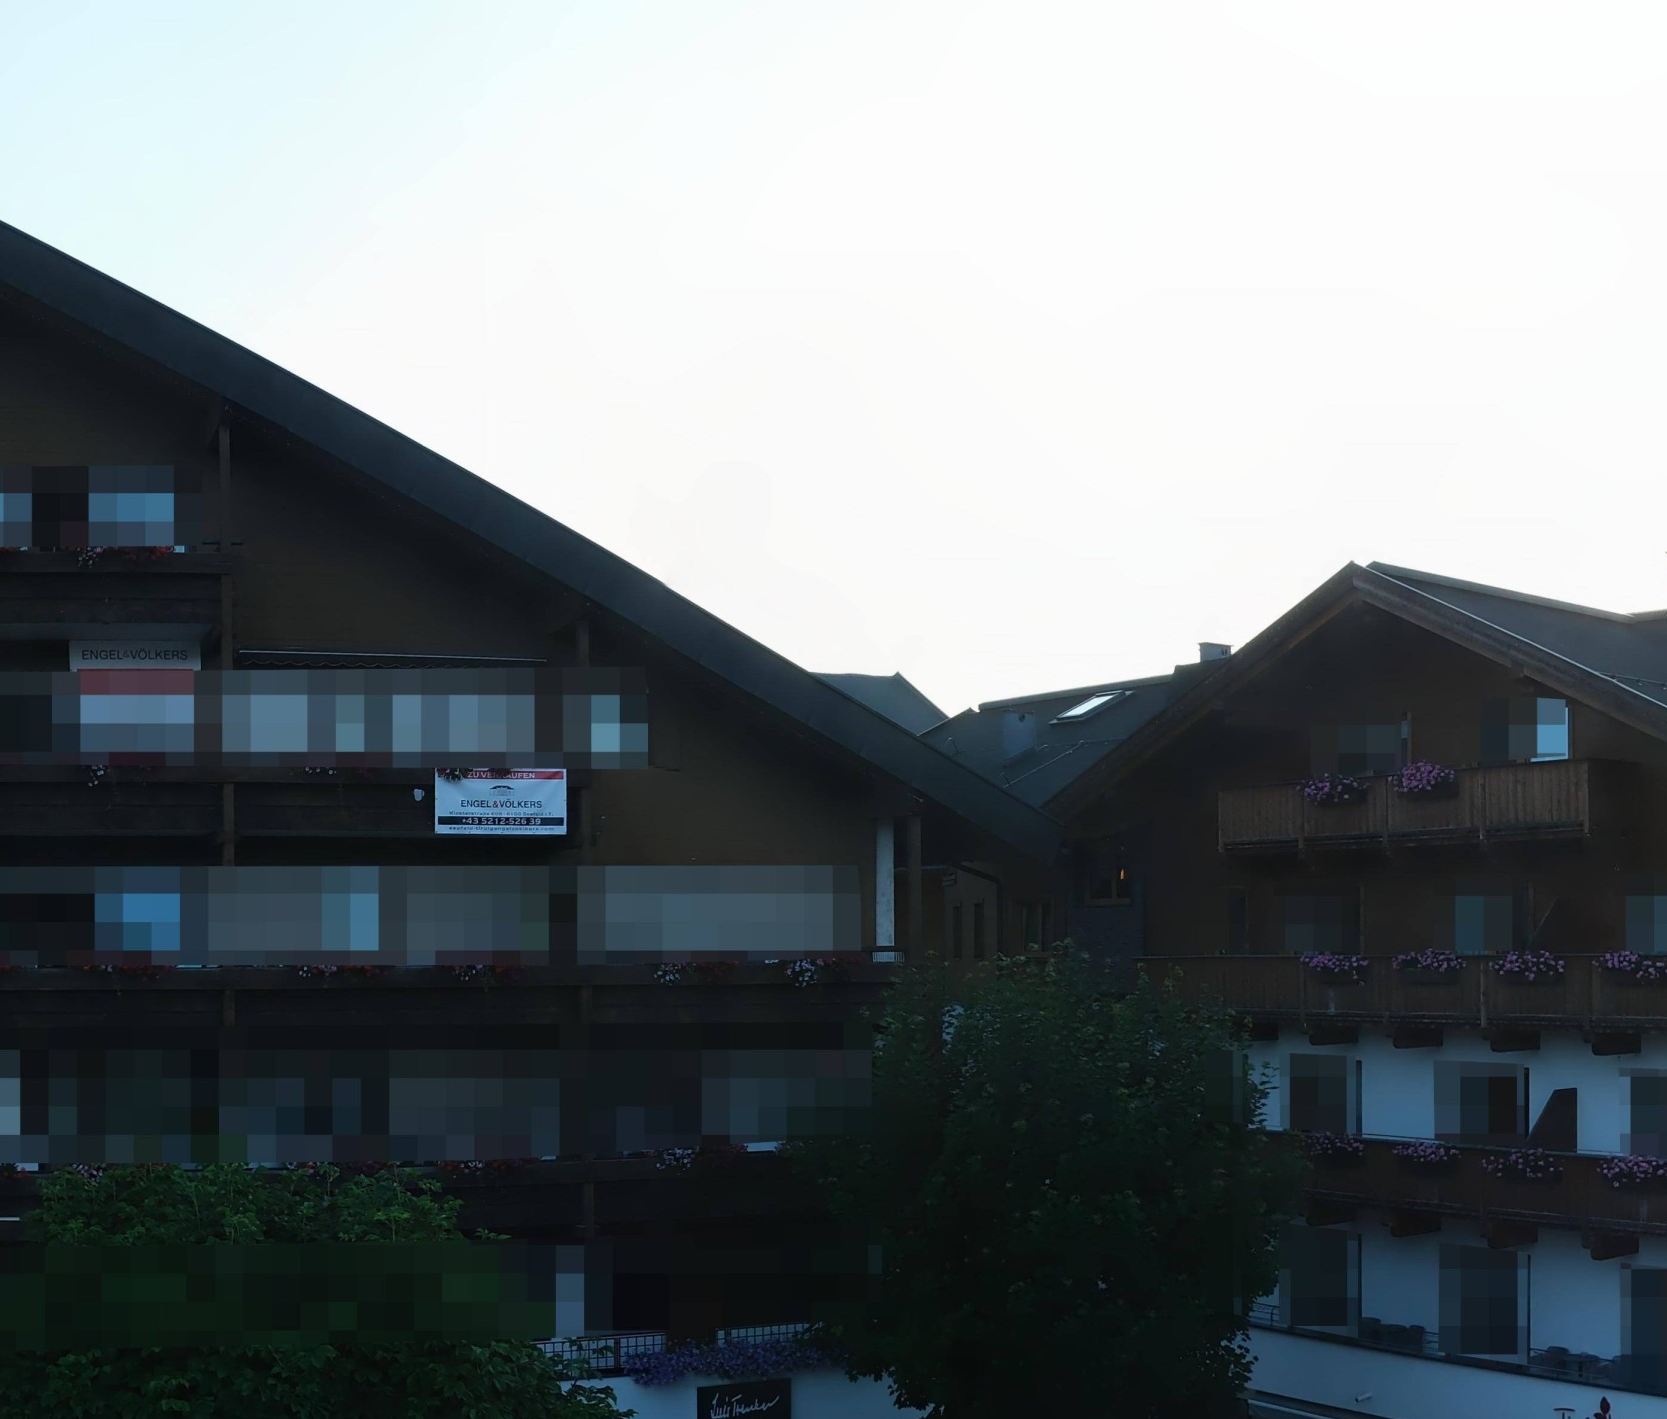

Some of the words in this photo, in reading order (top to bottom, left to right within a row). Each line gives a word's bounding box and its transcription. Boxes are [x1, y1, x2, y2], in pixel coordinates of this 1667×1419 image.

[82, 647, 188, 661] ENGEL&VÖLKERS
[467, 771, 479, 779] ZU
[482, 771, 536, 779] VEAUFEN
[460, 798, 543, 809] ENGEL&VÖLKERS
